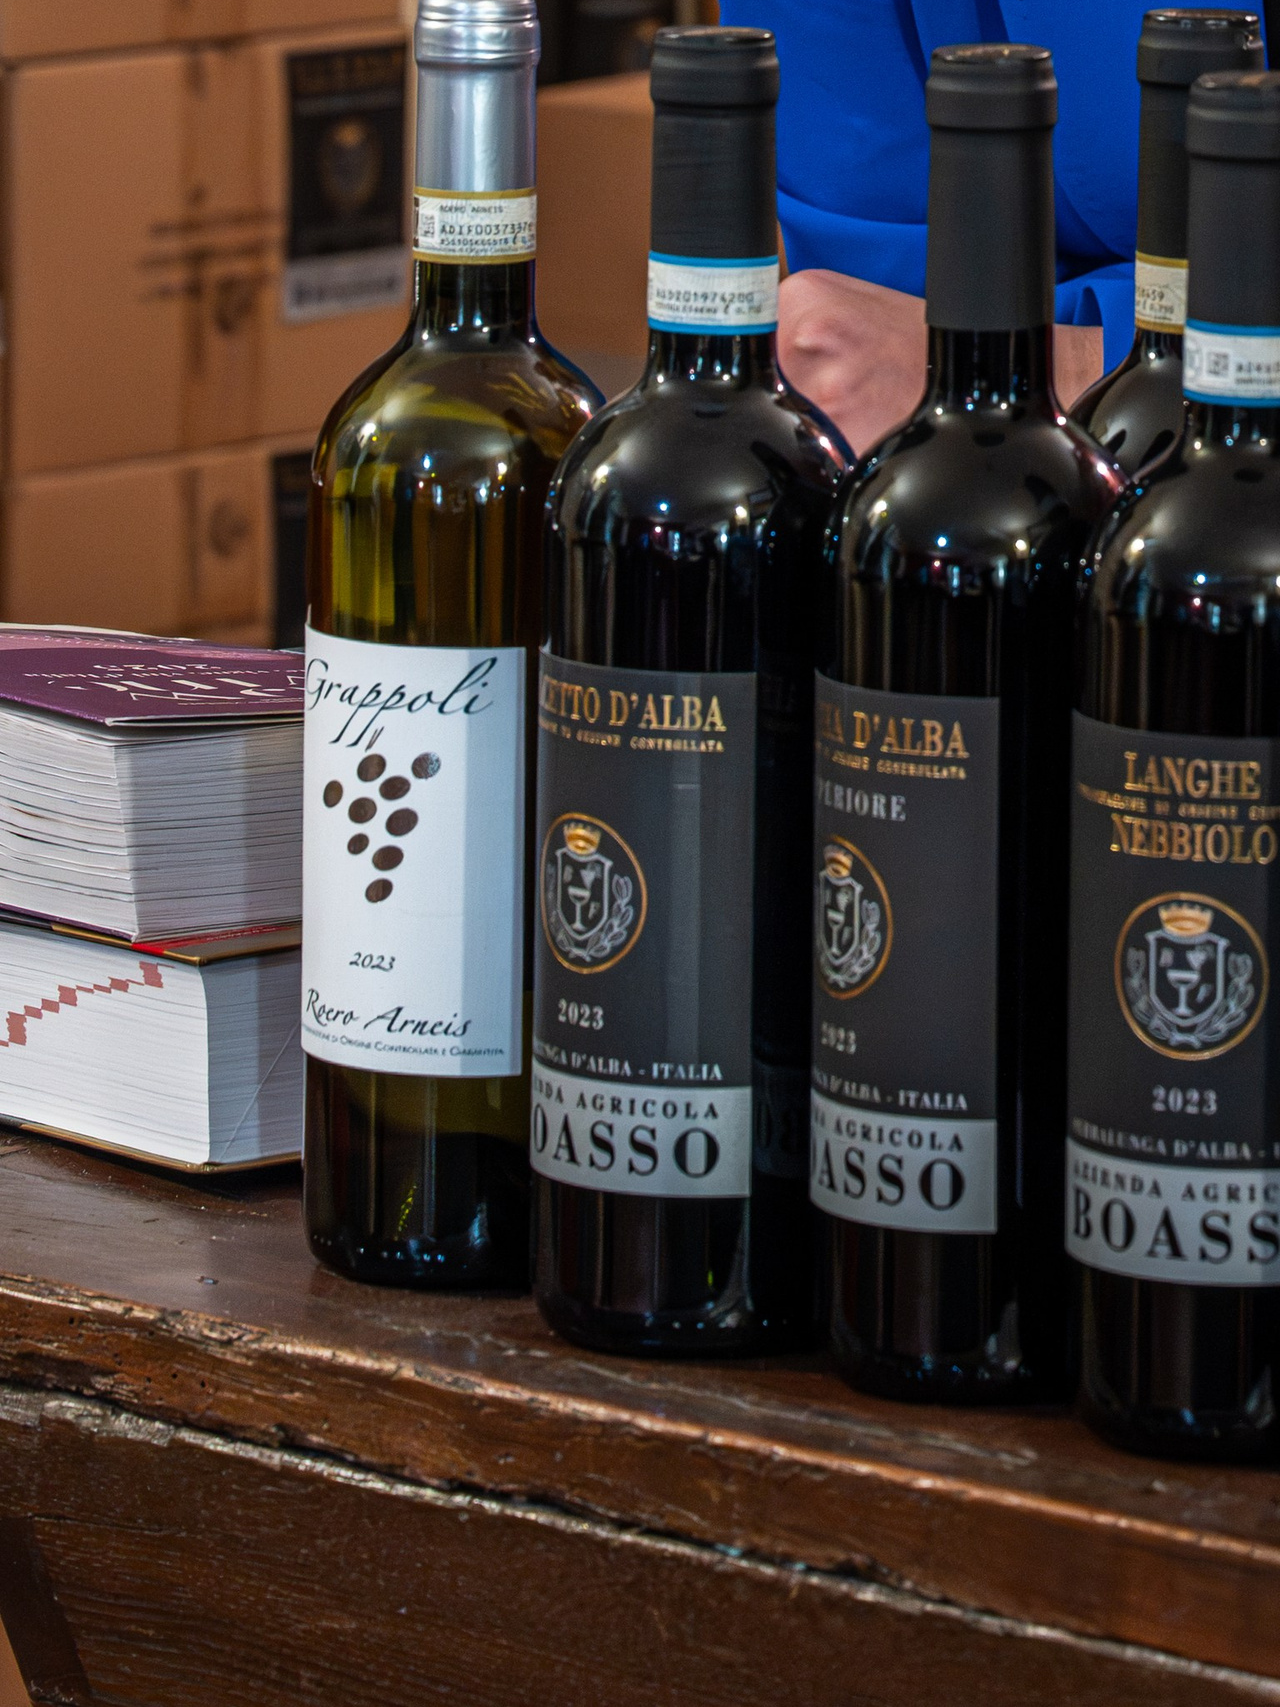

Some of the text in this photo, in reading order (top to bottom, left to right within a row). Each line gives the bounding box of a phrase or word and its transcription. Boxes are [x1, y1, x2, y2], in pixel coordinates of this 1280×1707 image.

[306, 658, 498, 748] Grappoli
[609, 690, 728, 732] D'ALBA
[852, 710, 970, 759] D'ALBA
[1123, 751, 1261, 800] LANGHE
[1109, 813, 1278, 866] NEBBIOLO
[349, 951, 396, 972] 2023
[306, 988, 360, 1027] Roero
[363, 1006, 473, 1038] Arneis
[557, 998, 604, 1031] 2023
[652, 1062, 724, 1081] ITALIA
[576, 1091, 719, 1120] AGRICOLA
[898, 1089, 968, 1112] ITALIA
[1151, 1085, 1218, 1116] 2023
[533, 1102, 721, 1179] OASSO
[834, 1115, 964, 1153] AGRICOLA
[811, 1139, 966, 1212] ASSO
